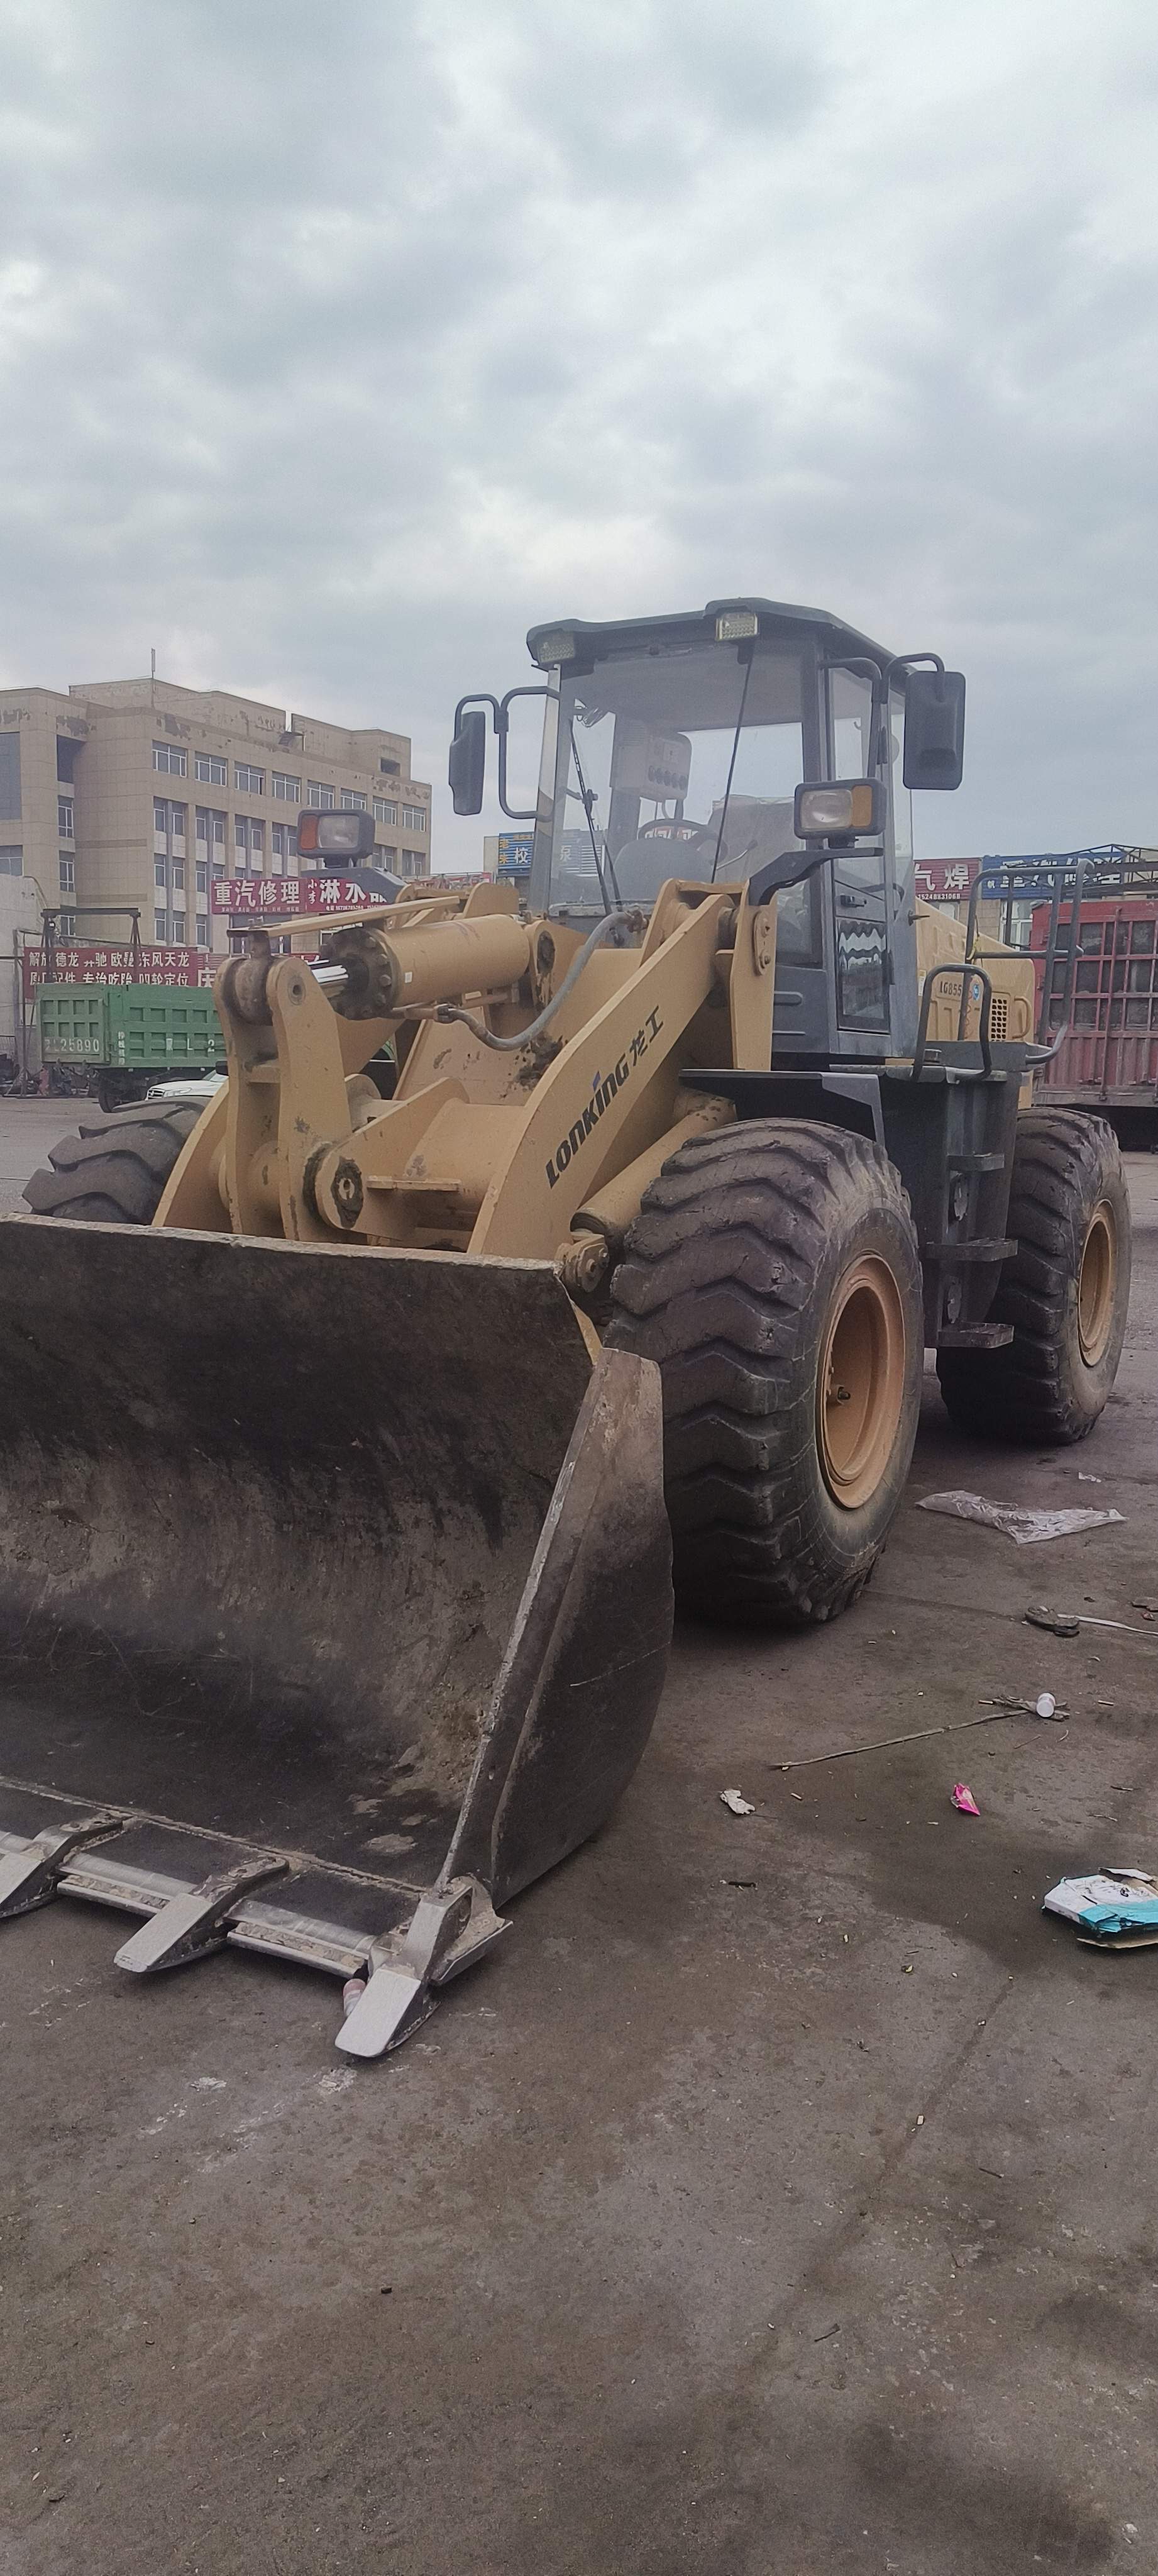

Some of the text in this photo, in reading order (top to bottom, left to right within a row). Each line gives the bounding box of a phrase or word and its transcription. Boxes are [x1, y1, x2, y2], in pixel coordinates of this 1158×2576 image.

[214, 880, 300, 908] 重汽修理
[55, 952, 79, 967] 德龙
[138, 952, 190, 967] 东风天龙
[629, 1005, 664, 1066] 龙工
